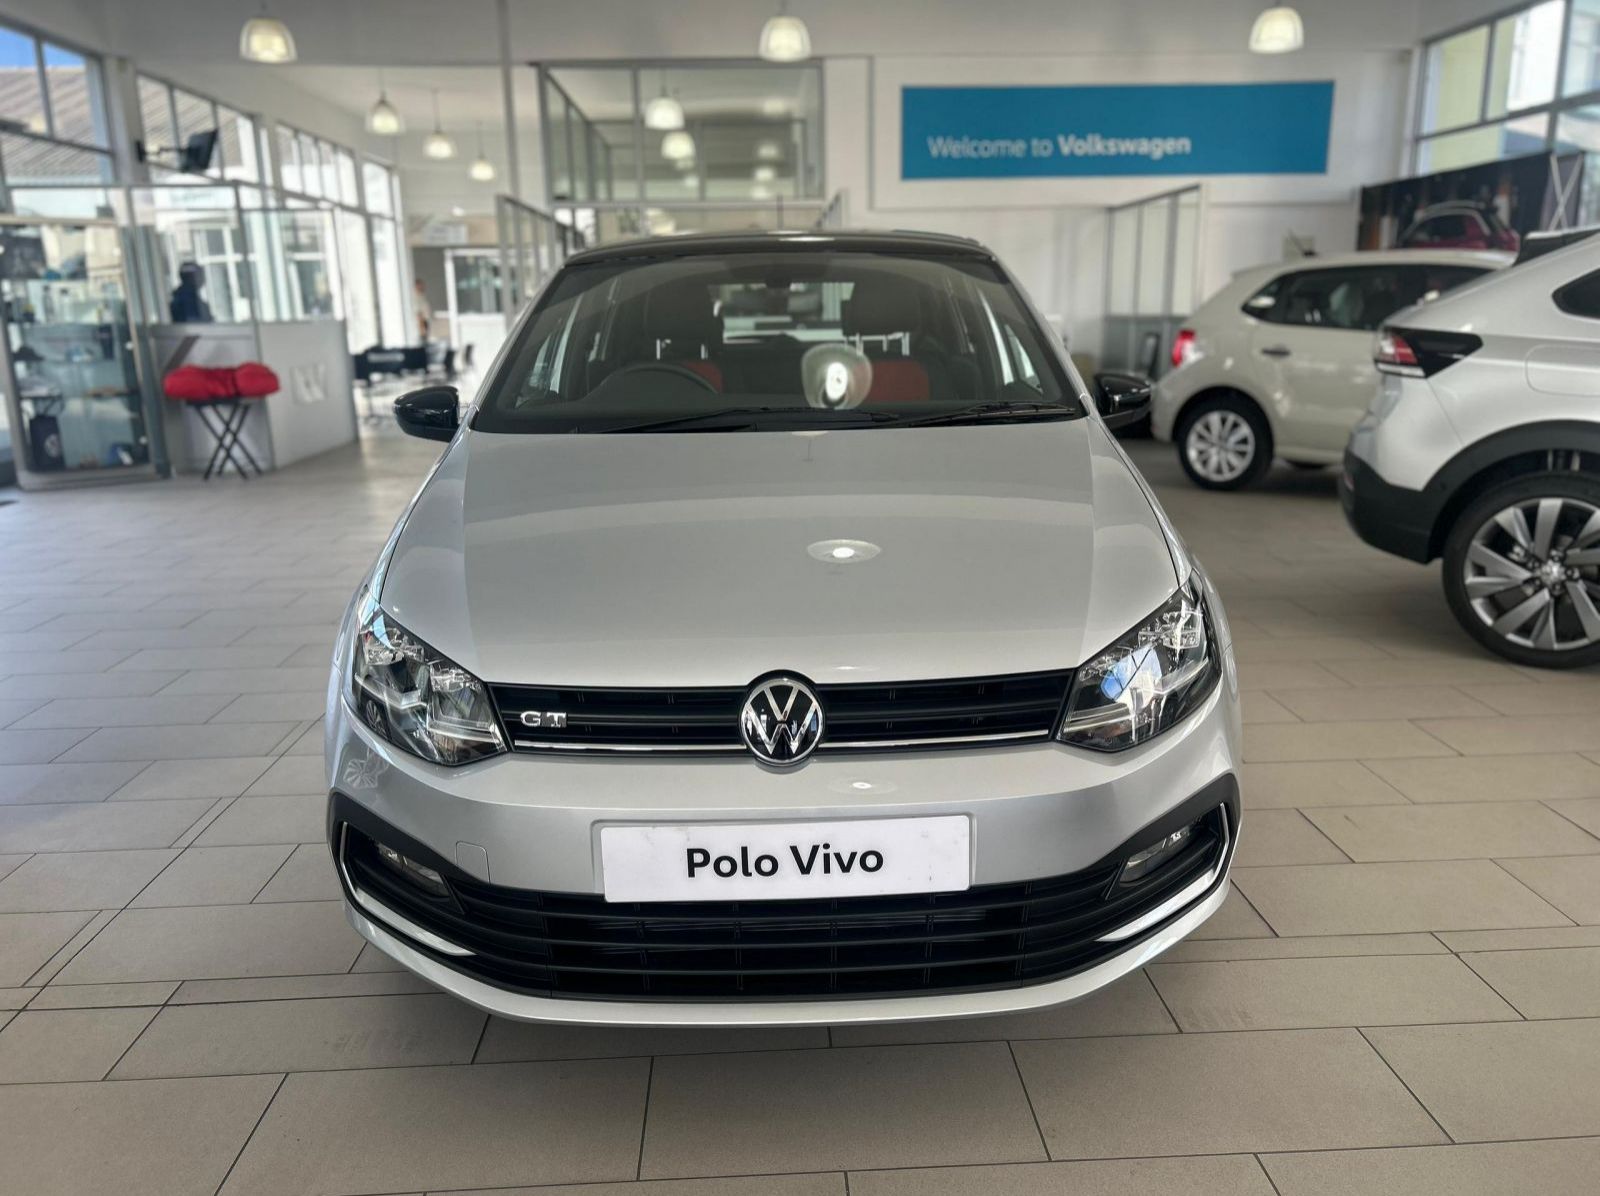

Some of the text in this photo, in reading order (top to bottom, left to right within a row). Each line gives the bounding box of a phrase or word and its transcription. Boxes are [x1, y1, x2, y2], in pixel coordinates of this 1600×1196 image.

[927, 133, 1192, 161] Welcome to Volkswagen
[742, 679, 822, 762] VW
[686, 842, 884, 878] Polo Vivo
